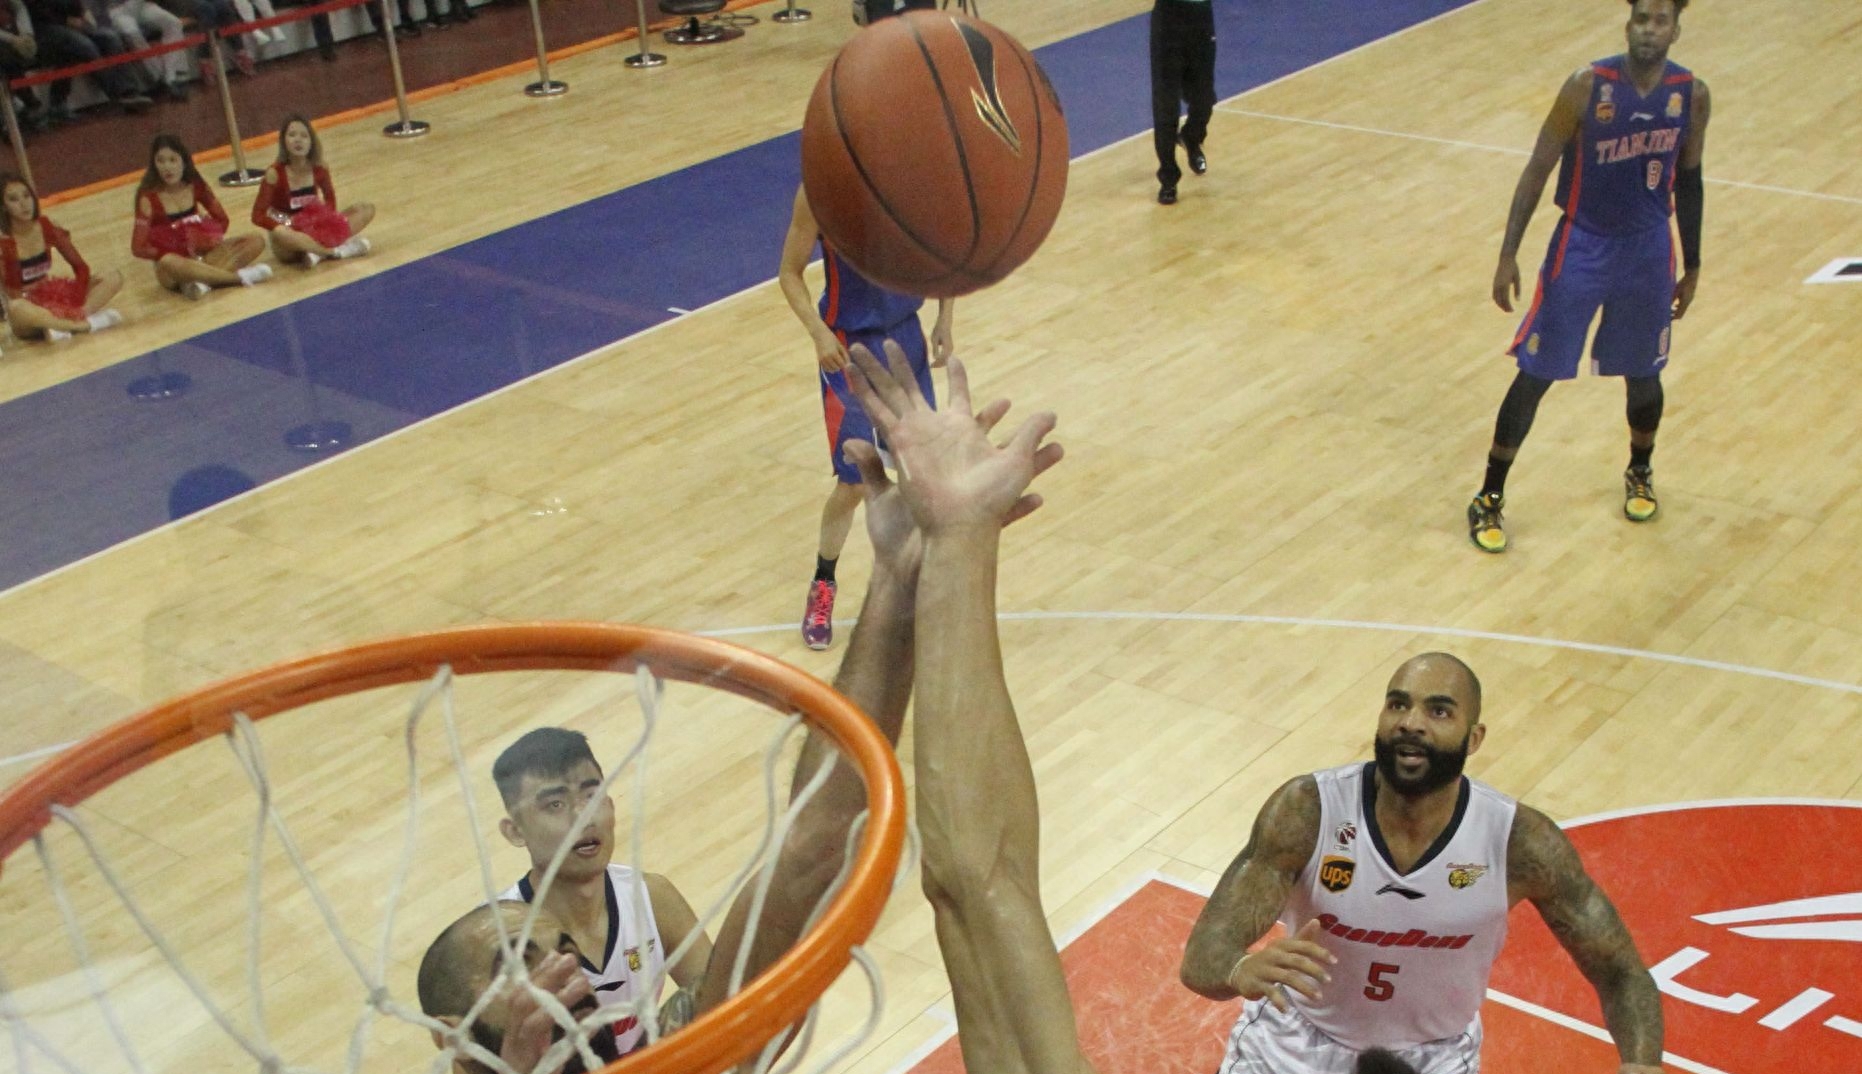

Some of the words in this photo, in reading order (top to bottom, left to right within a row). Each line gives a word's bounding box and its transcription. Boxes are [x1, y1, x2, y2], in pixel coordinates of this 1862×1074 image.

[1596, 127, 1681, 164] TIANJIN
[1646, 159, 1663, 190] 8
[1322, 865, 1351, 887] ups
[1363, 961, 1400, 1001] 5
